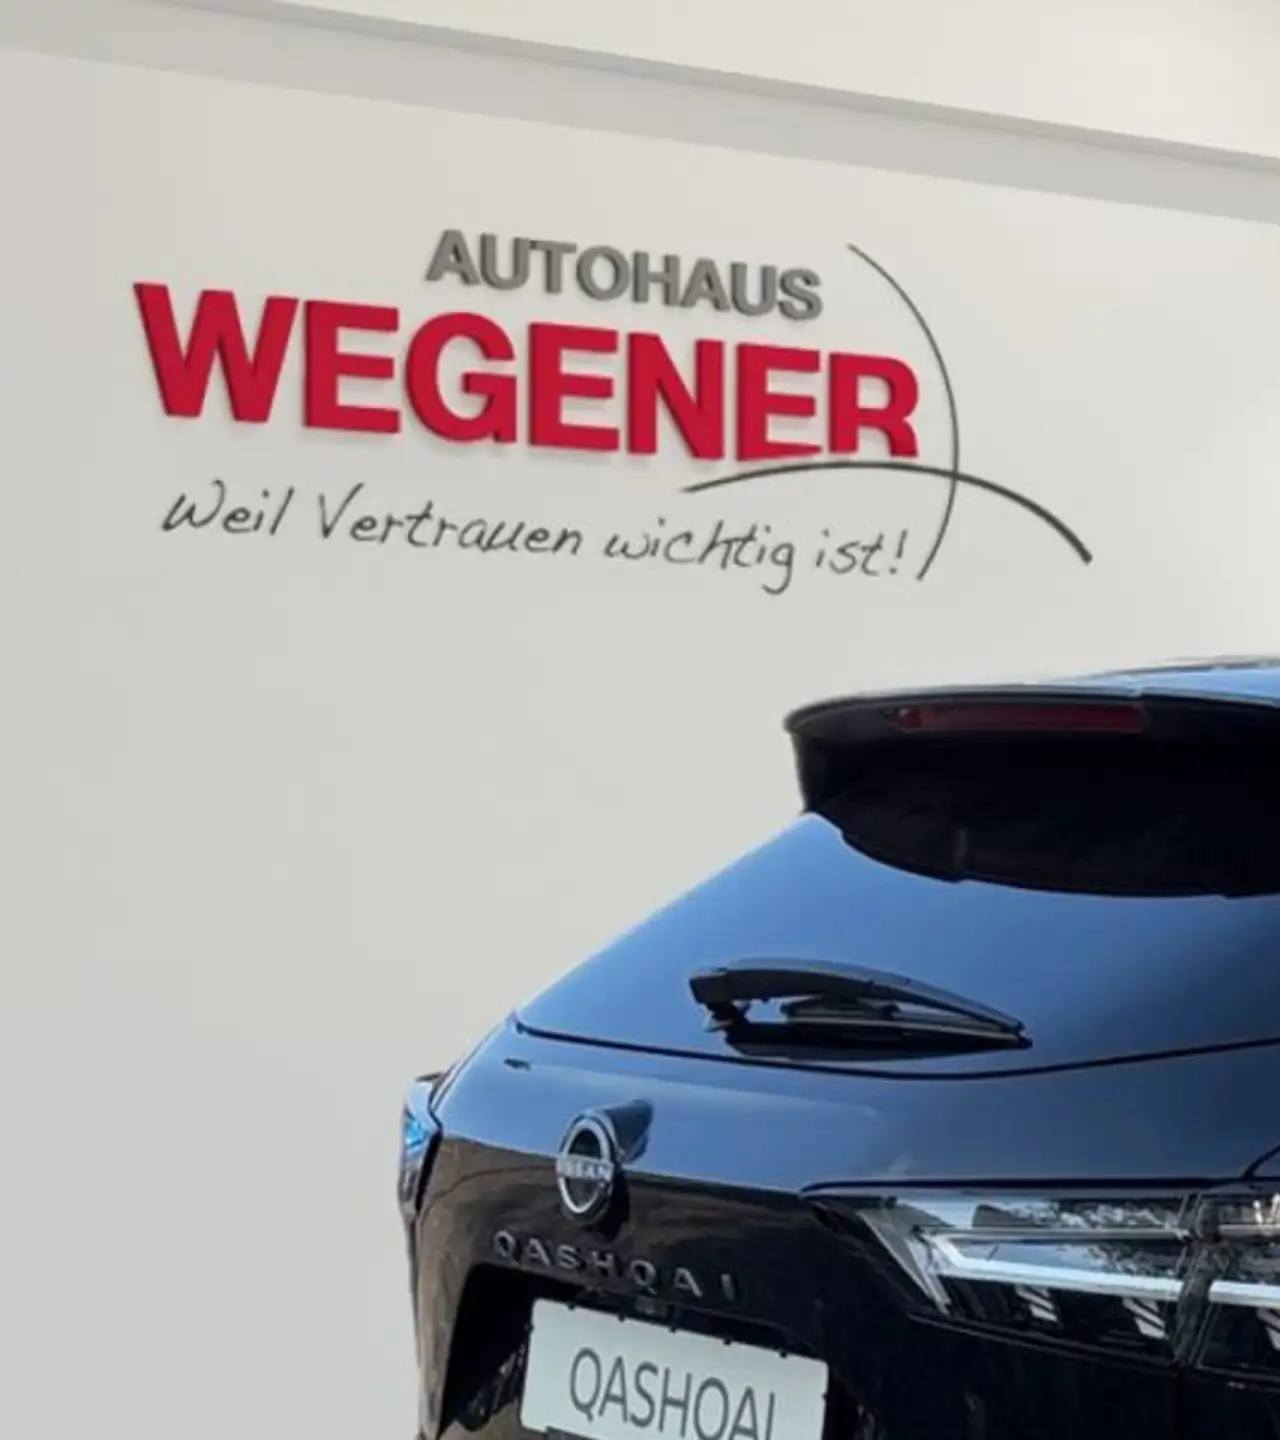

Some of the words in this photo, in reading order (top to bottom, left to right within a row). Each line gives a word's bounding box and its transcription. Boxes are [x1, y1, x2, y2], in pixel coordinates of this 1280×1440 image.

[426, 229, 824, 322] AUTOHAUS
[133, 282, 920, 462] WEGENER
[161, 478, 295, 535] Weil
[317, 482, 583, 556] Vertrauen
[602, 516, 795, 596] wichtig
[814, 528, 908, 577] ist!
[493, 1230, 740, 1301] QASHQAI
